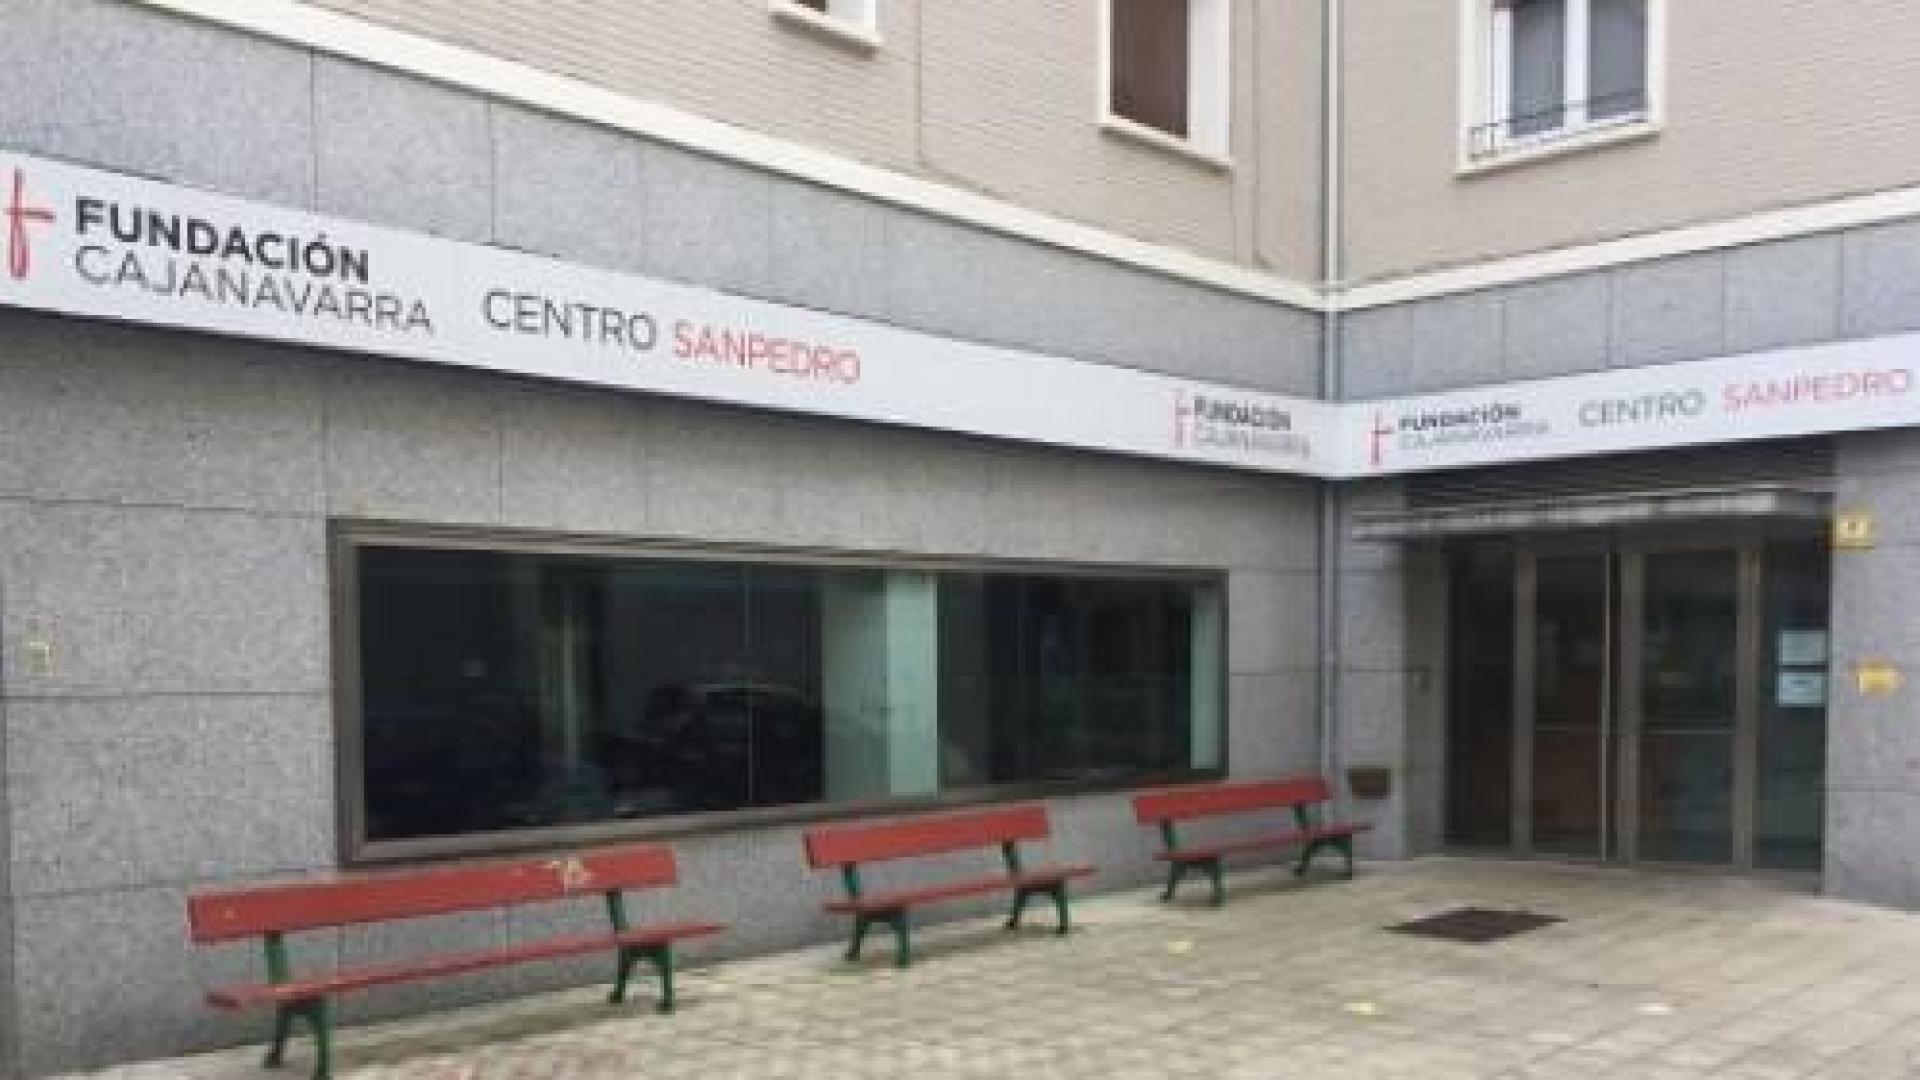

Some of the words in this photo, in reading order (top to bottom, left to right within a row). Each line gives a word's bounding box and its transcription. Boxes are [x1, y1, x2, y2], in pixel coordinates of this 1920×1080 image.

[75, 195, 369, 283] FUNDACIÓN
[75, 245, 434, 335] CAJANAVARRA
[484, 287, 658, 352] CENTRO
[673, 319, 861, 385] SANPEDRO
[1578, 388, 1706, 427] CENTRO
[1722, 368, 1911, 411] SANPEDRO
